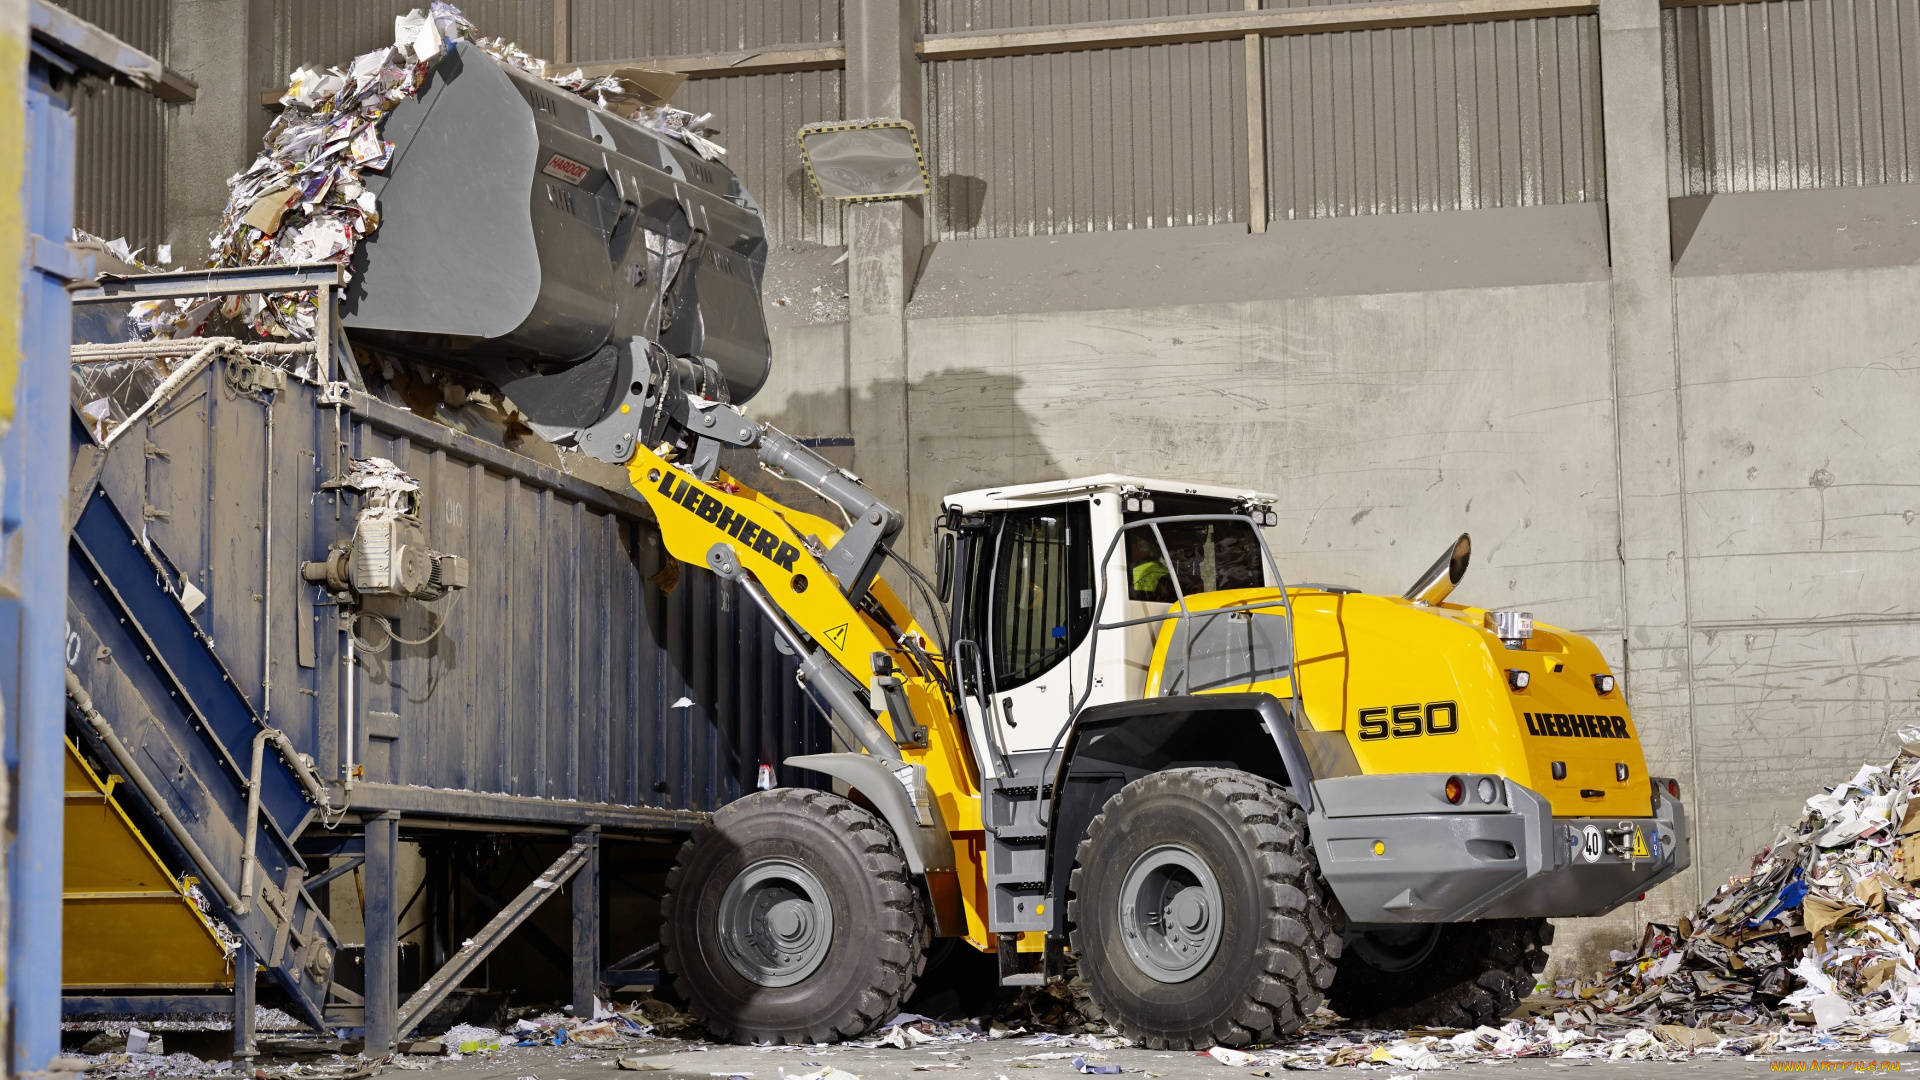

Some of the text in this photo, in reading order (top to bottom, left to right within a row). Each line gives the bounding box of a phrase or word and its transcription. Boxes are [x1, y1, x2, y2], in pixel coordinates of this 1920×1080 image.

[549, 157, 587, 178] HARDOX
[657, 470, 801, 573] LIEBHERR
[1358, 700, 1460, 742] 550
[1523, 712, 1631, 739] LIEBHERR
[1586, 832, 1599, 856] 40
